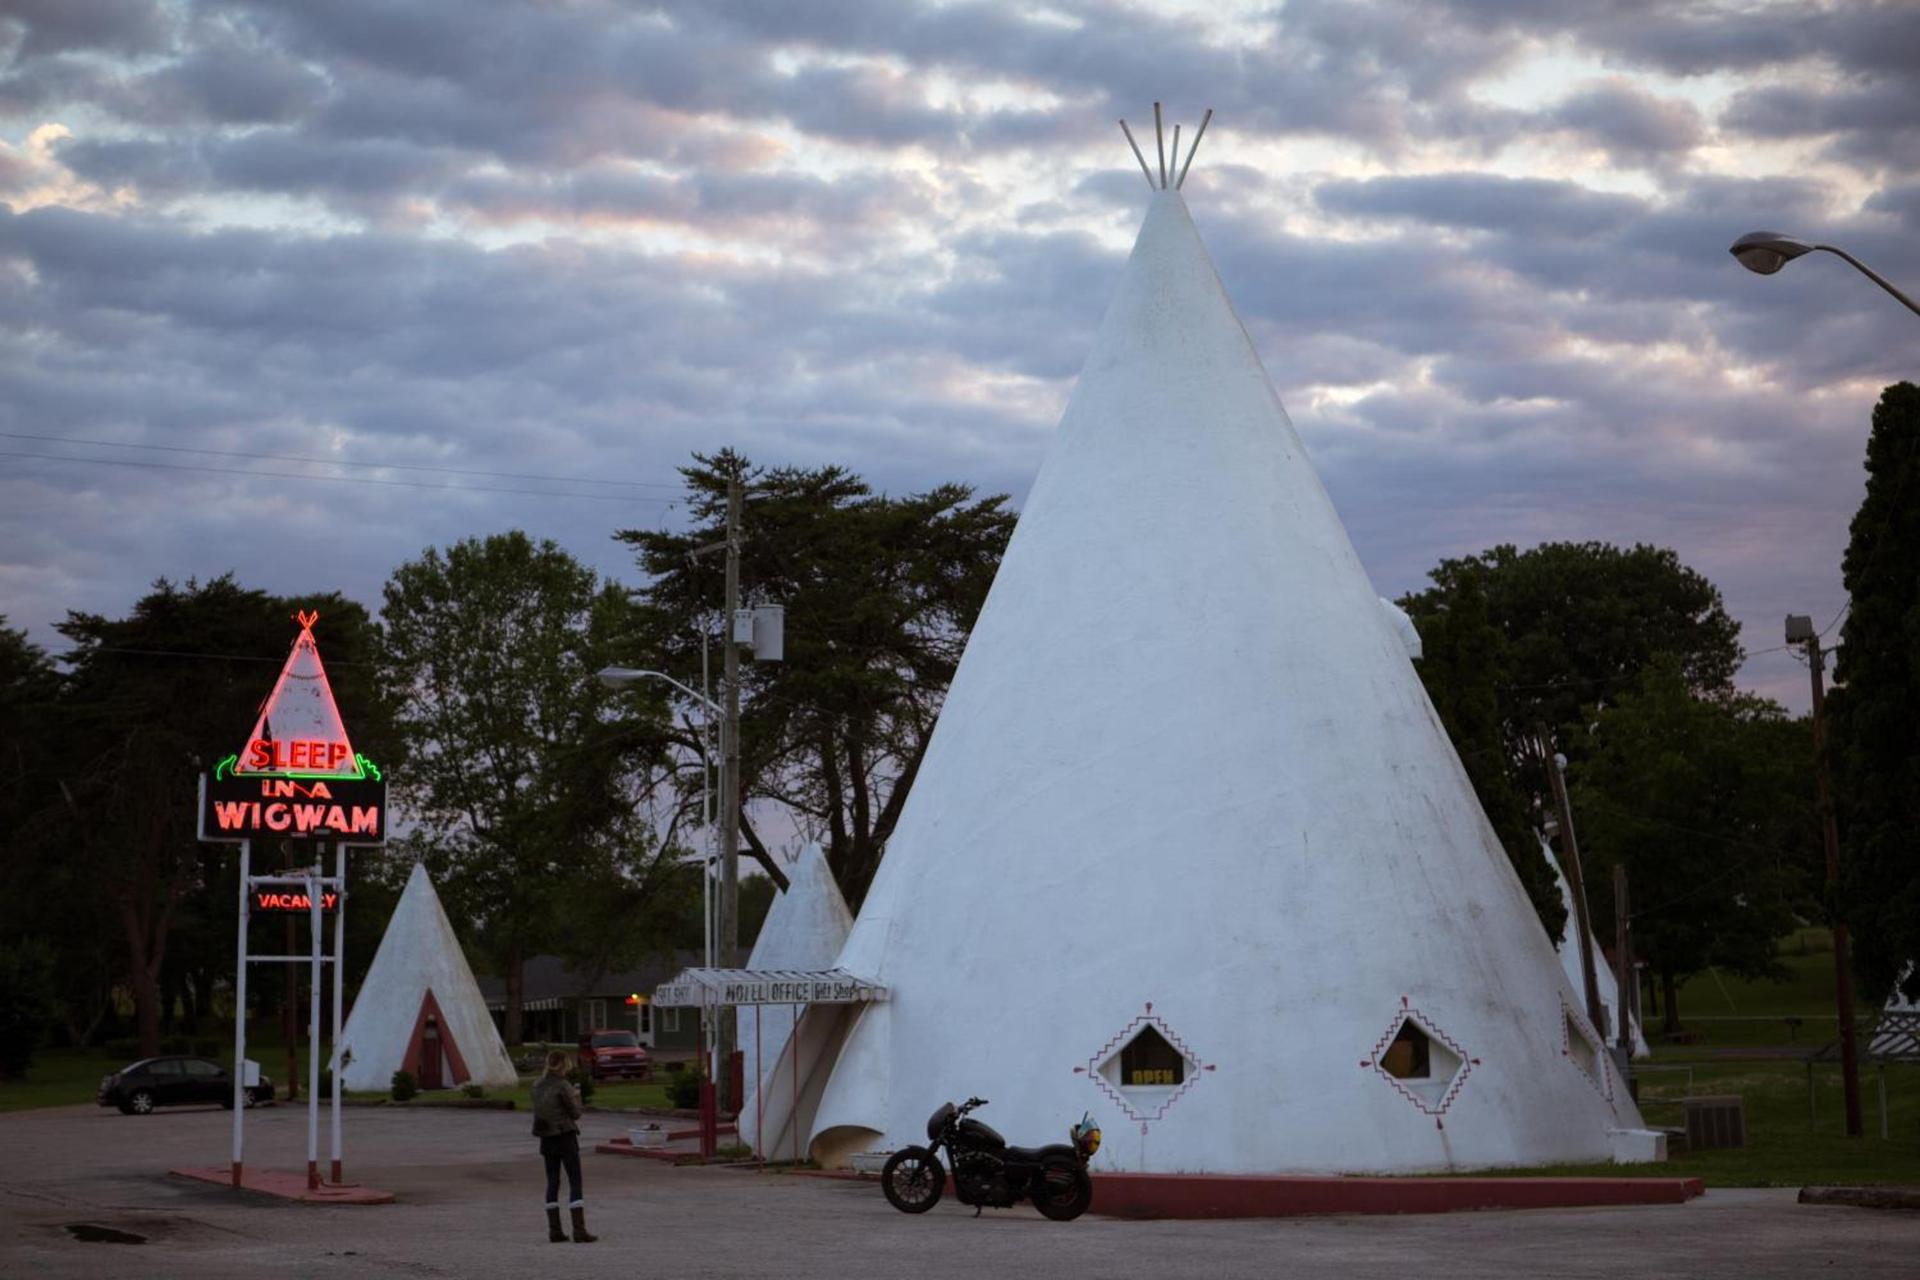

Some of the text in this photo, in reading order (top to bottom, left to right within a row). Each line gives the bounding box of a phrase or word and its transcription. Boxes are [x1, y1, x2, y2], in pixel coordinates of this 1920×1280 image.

[249, 739, 347, 769] SLEEP
[262, 779, 332, 799] IN A
[214, 801, 379, 834] WIGWAM
[771, 982, 808, 1000] OFFICE
